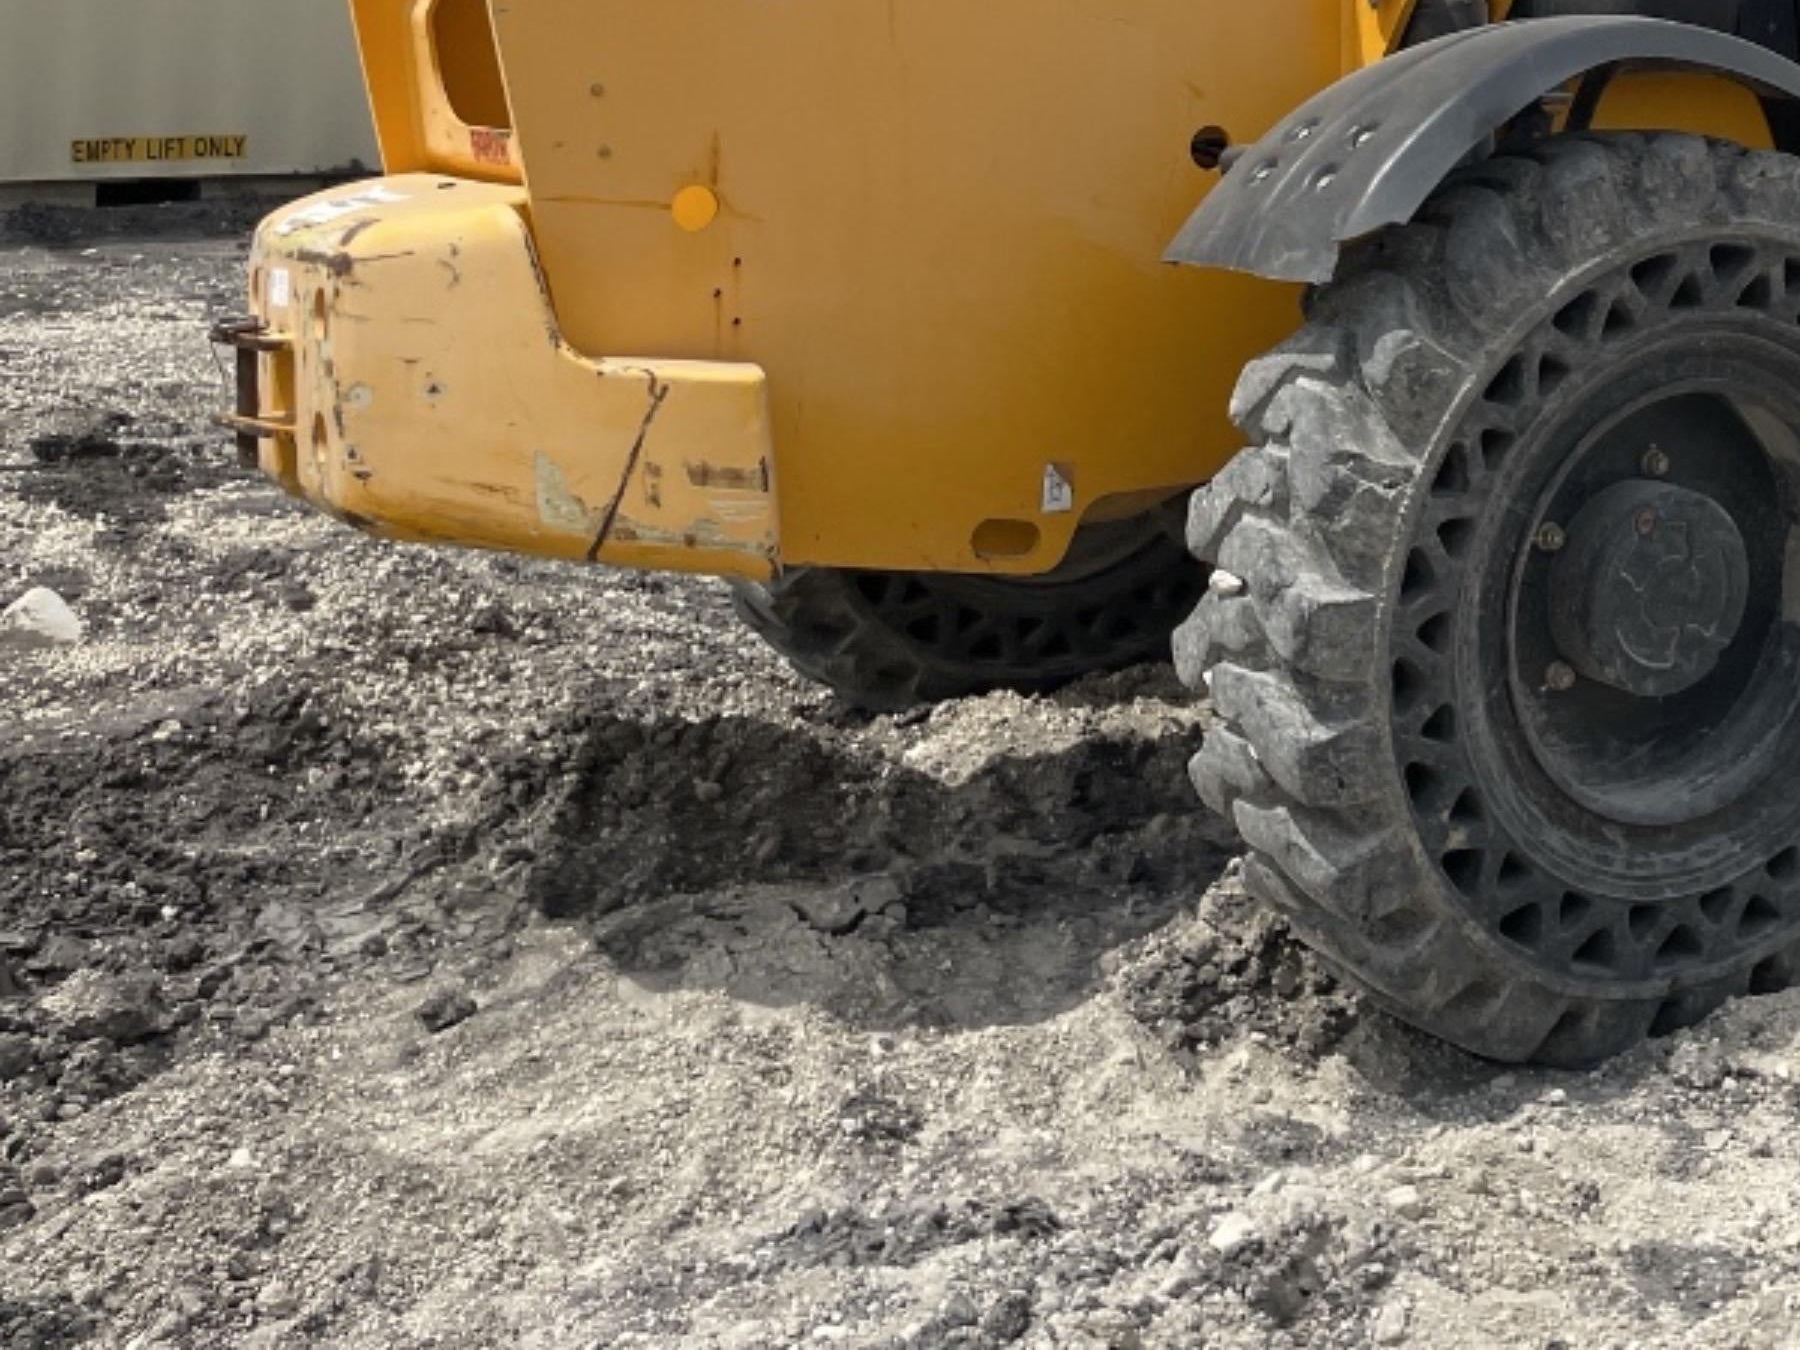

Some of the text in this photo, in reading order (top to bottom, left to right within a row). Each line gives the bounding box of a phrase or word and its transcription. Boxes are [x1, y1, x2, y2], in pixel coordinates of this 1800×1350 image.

[71, 134, 247, 163] EMPTY LIFT ONLY
